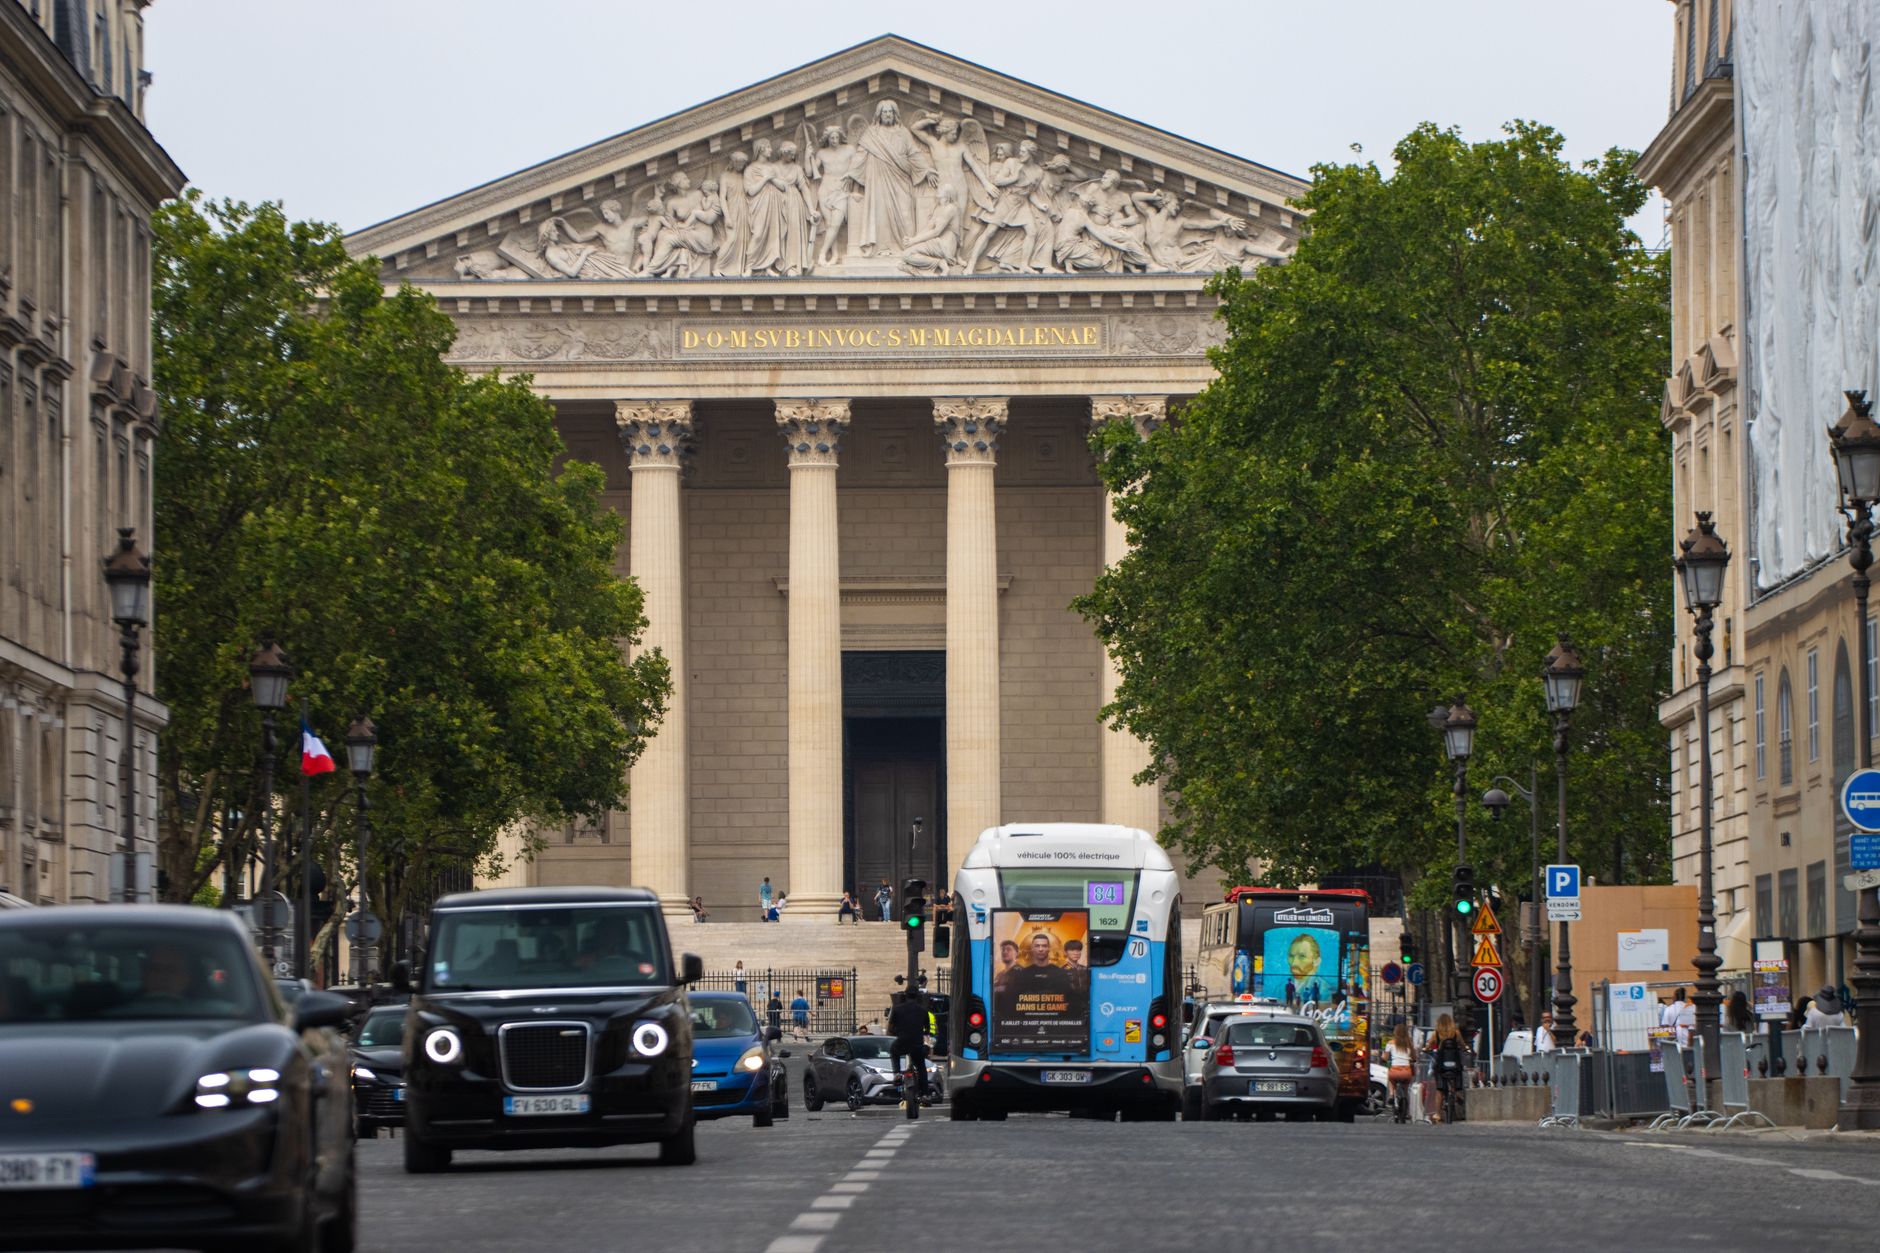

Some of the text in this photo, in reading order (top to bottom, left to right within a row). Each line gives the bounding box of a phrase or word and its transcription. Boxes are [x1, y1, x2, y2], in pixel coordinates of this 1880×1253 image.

[1017, 851, 1120, 862] véhicule 100% électrique
[1556, 872, 1571, 893] P
[1094, 886, 1116, 903] 84
[1099, 916, 1118, 926] 1629
[1132, 941, 1145, 957] 70
[1753, 960, 1789, 969] GOSPEL
[1479, 976, 1497, 992] 30
[1019, 994, 1065, 1002] PARIS ENTRE
[1016, 1003, 1068, 1011] DANS LE GAME
[1299, 1000, 1348, 1030] Gogh
